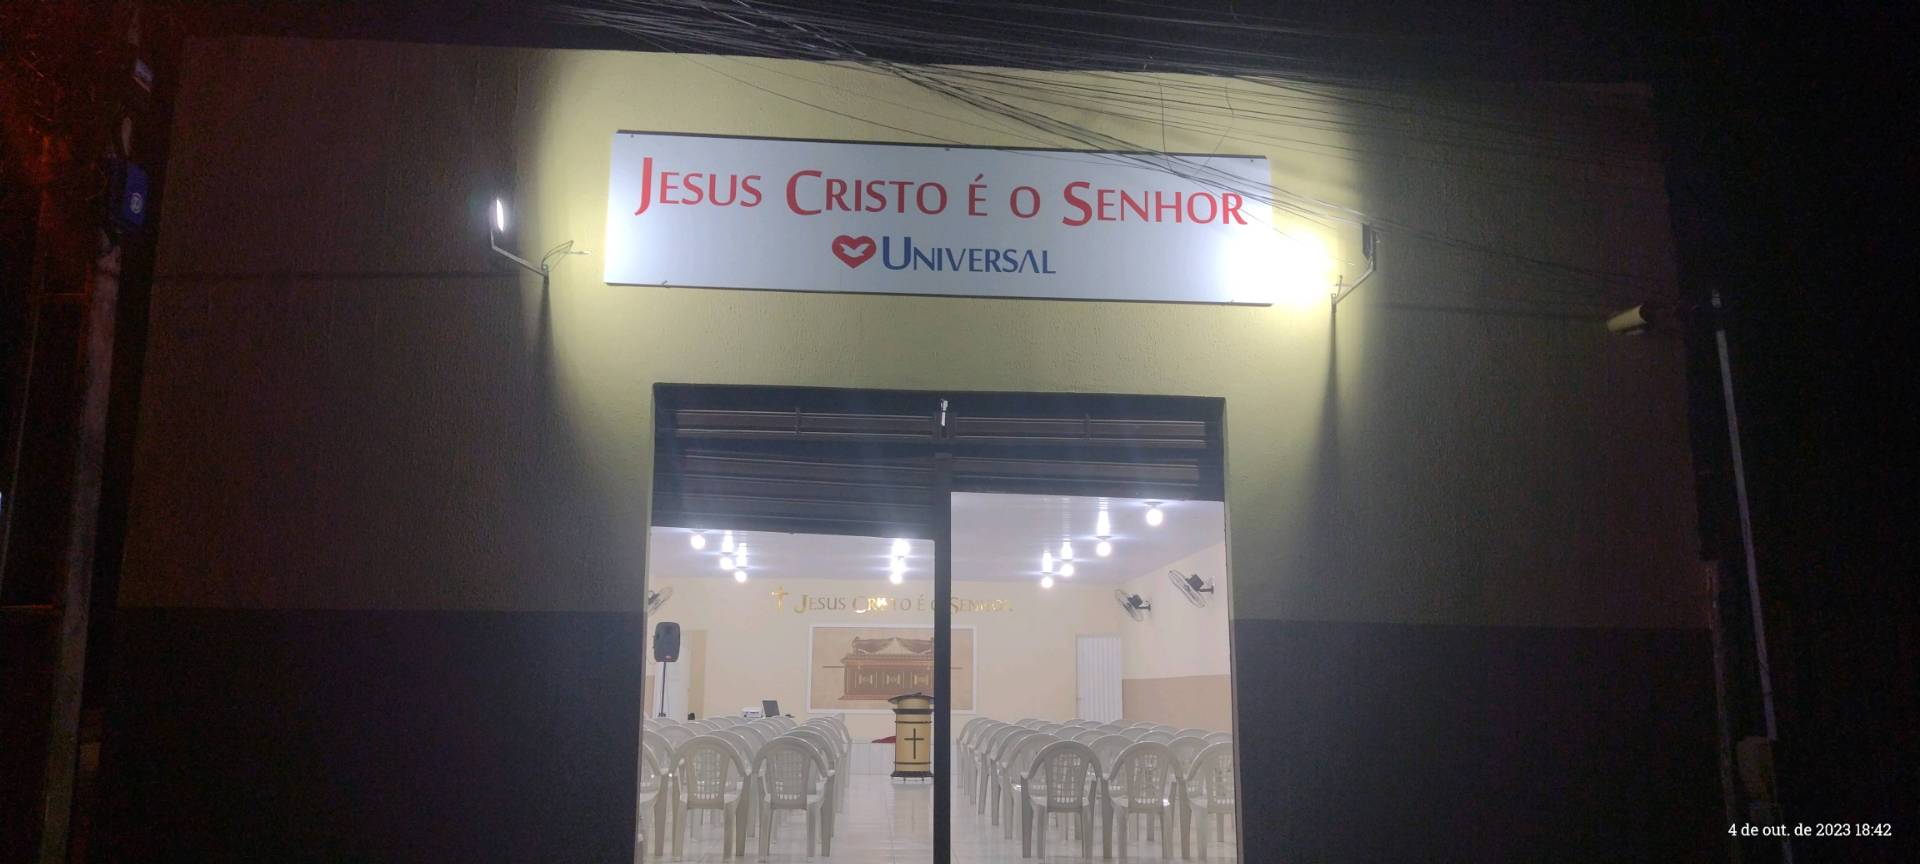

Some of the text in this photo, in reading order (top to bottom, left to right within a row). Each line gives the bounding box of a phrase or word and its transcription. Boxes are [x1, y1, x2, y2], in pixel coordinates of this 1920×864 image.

[634, 156, 1248, 227] JESUS CRISTO É O SENHOR
[882, 236, 1057, 274] UNIVERSAL
[794, 594, 847, 614] JESUS
